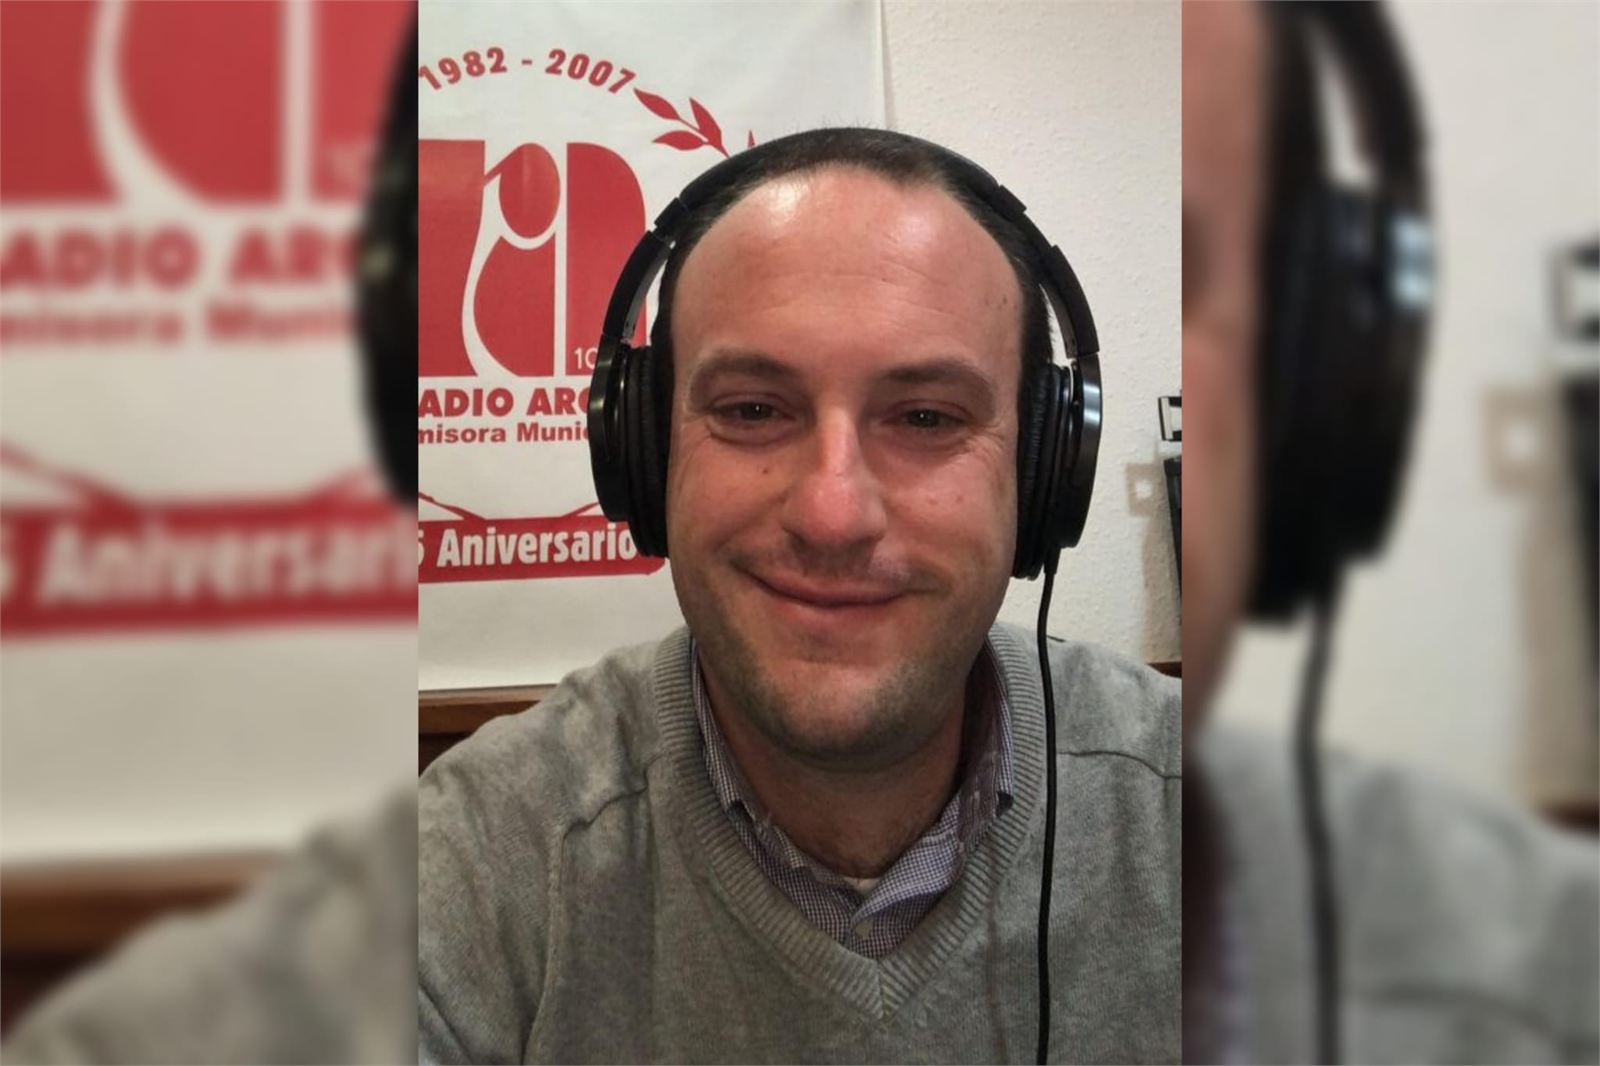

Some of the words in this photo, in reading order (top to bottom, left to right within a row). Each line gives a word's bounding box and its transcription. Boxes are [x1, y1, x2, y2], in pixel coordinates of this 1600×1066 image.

[418, 47, 507, 90] 1982
[545, 48, 636, 94] 2007
[418, 388, 514, 417] ADIO
[436, 521, 638, 568] Aniversario
